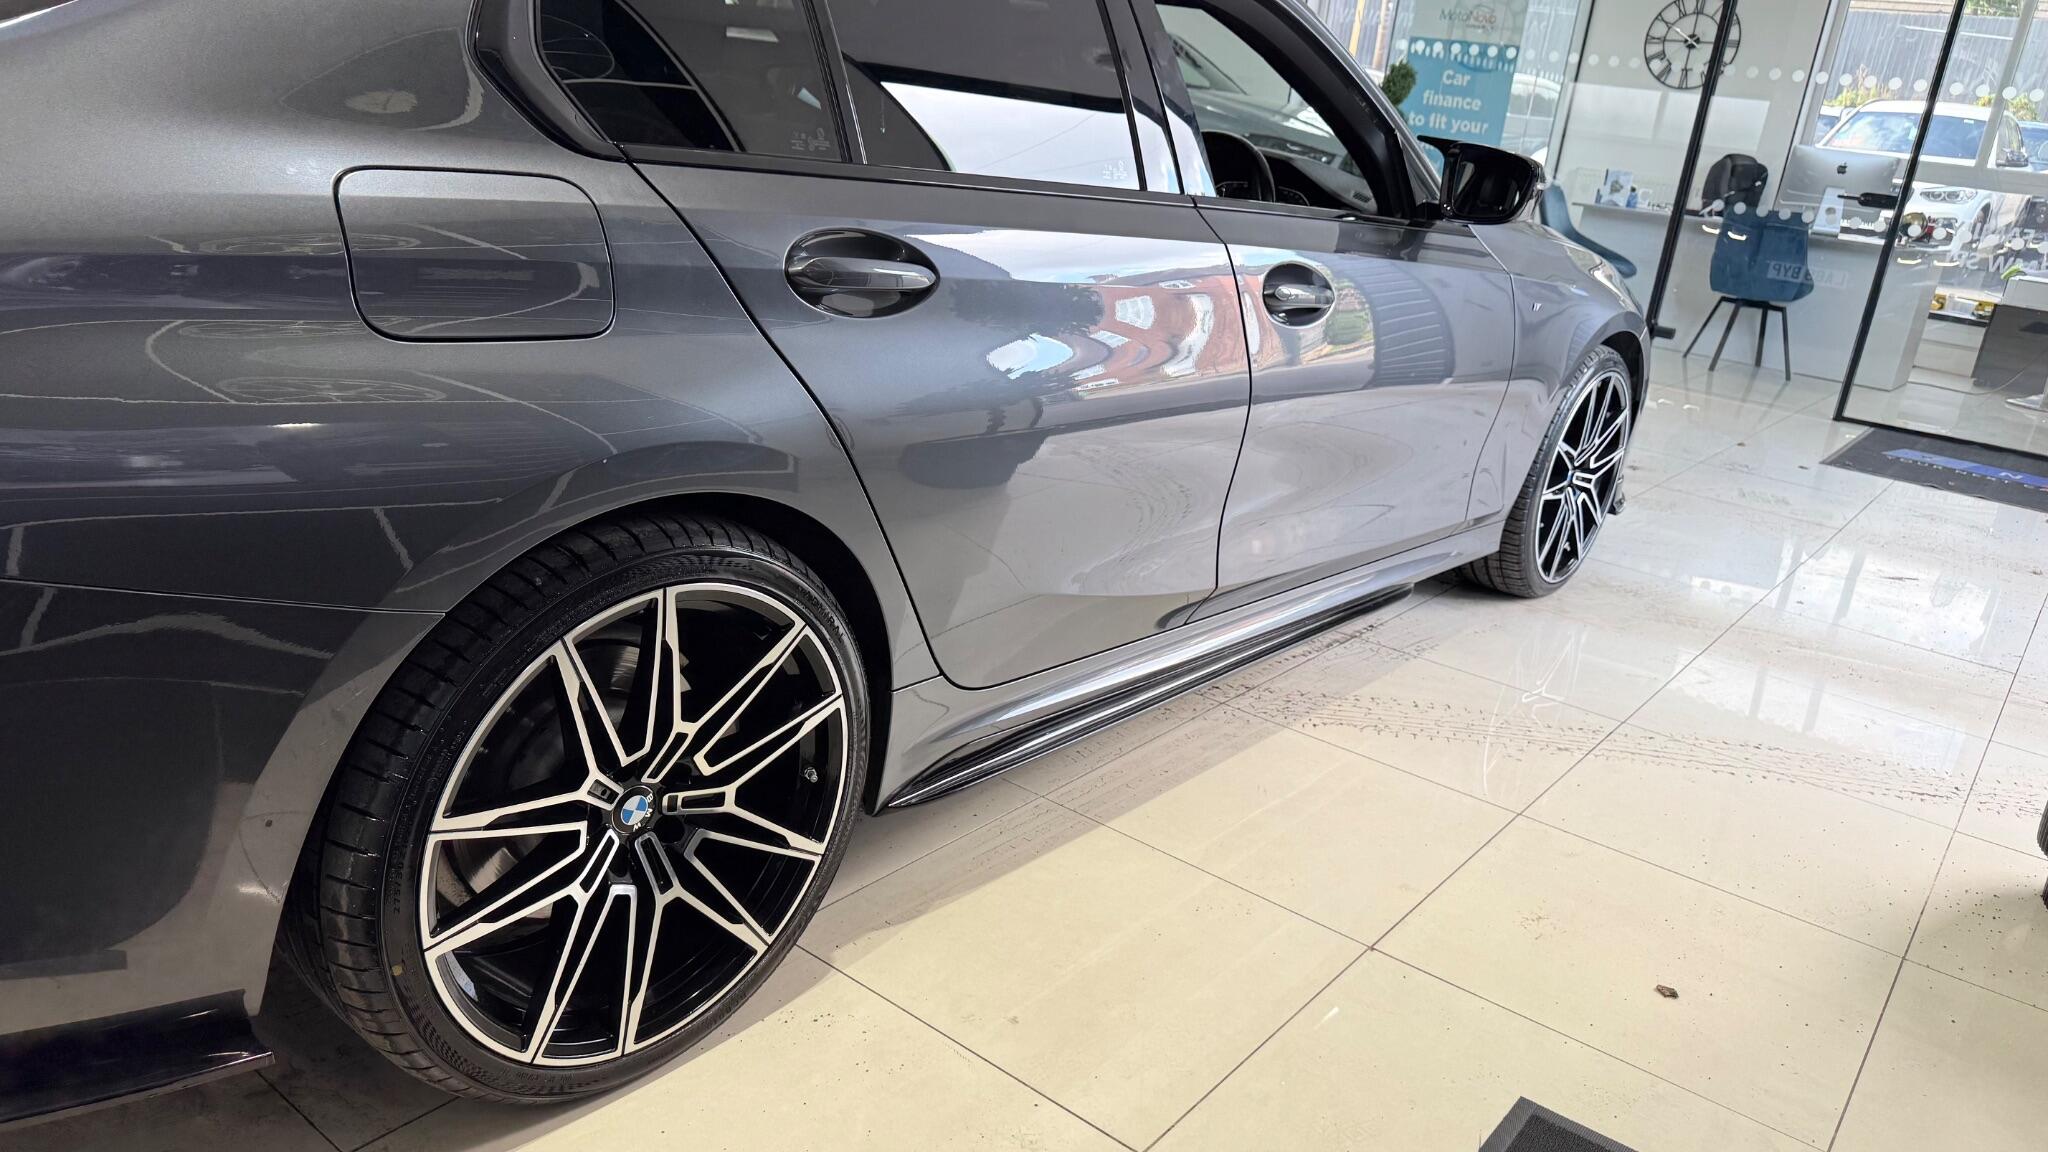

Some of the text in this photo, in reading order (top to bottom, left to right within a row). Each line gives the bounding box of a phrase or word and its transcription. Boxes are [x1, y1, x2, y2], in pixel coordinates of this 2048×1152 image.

[1442, 69, 1472, 88] Car
[1423, 90, 1483, 111] finance
[1408, 111, 1489, 137] to fit your
[630, 792, 654, 832] BMW
